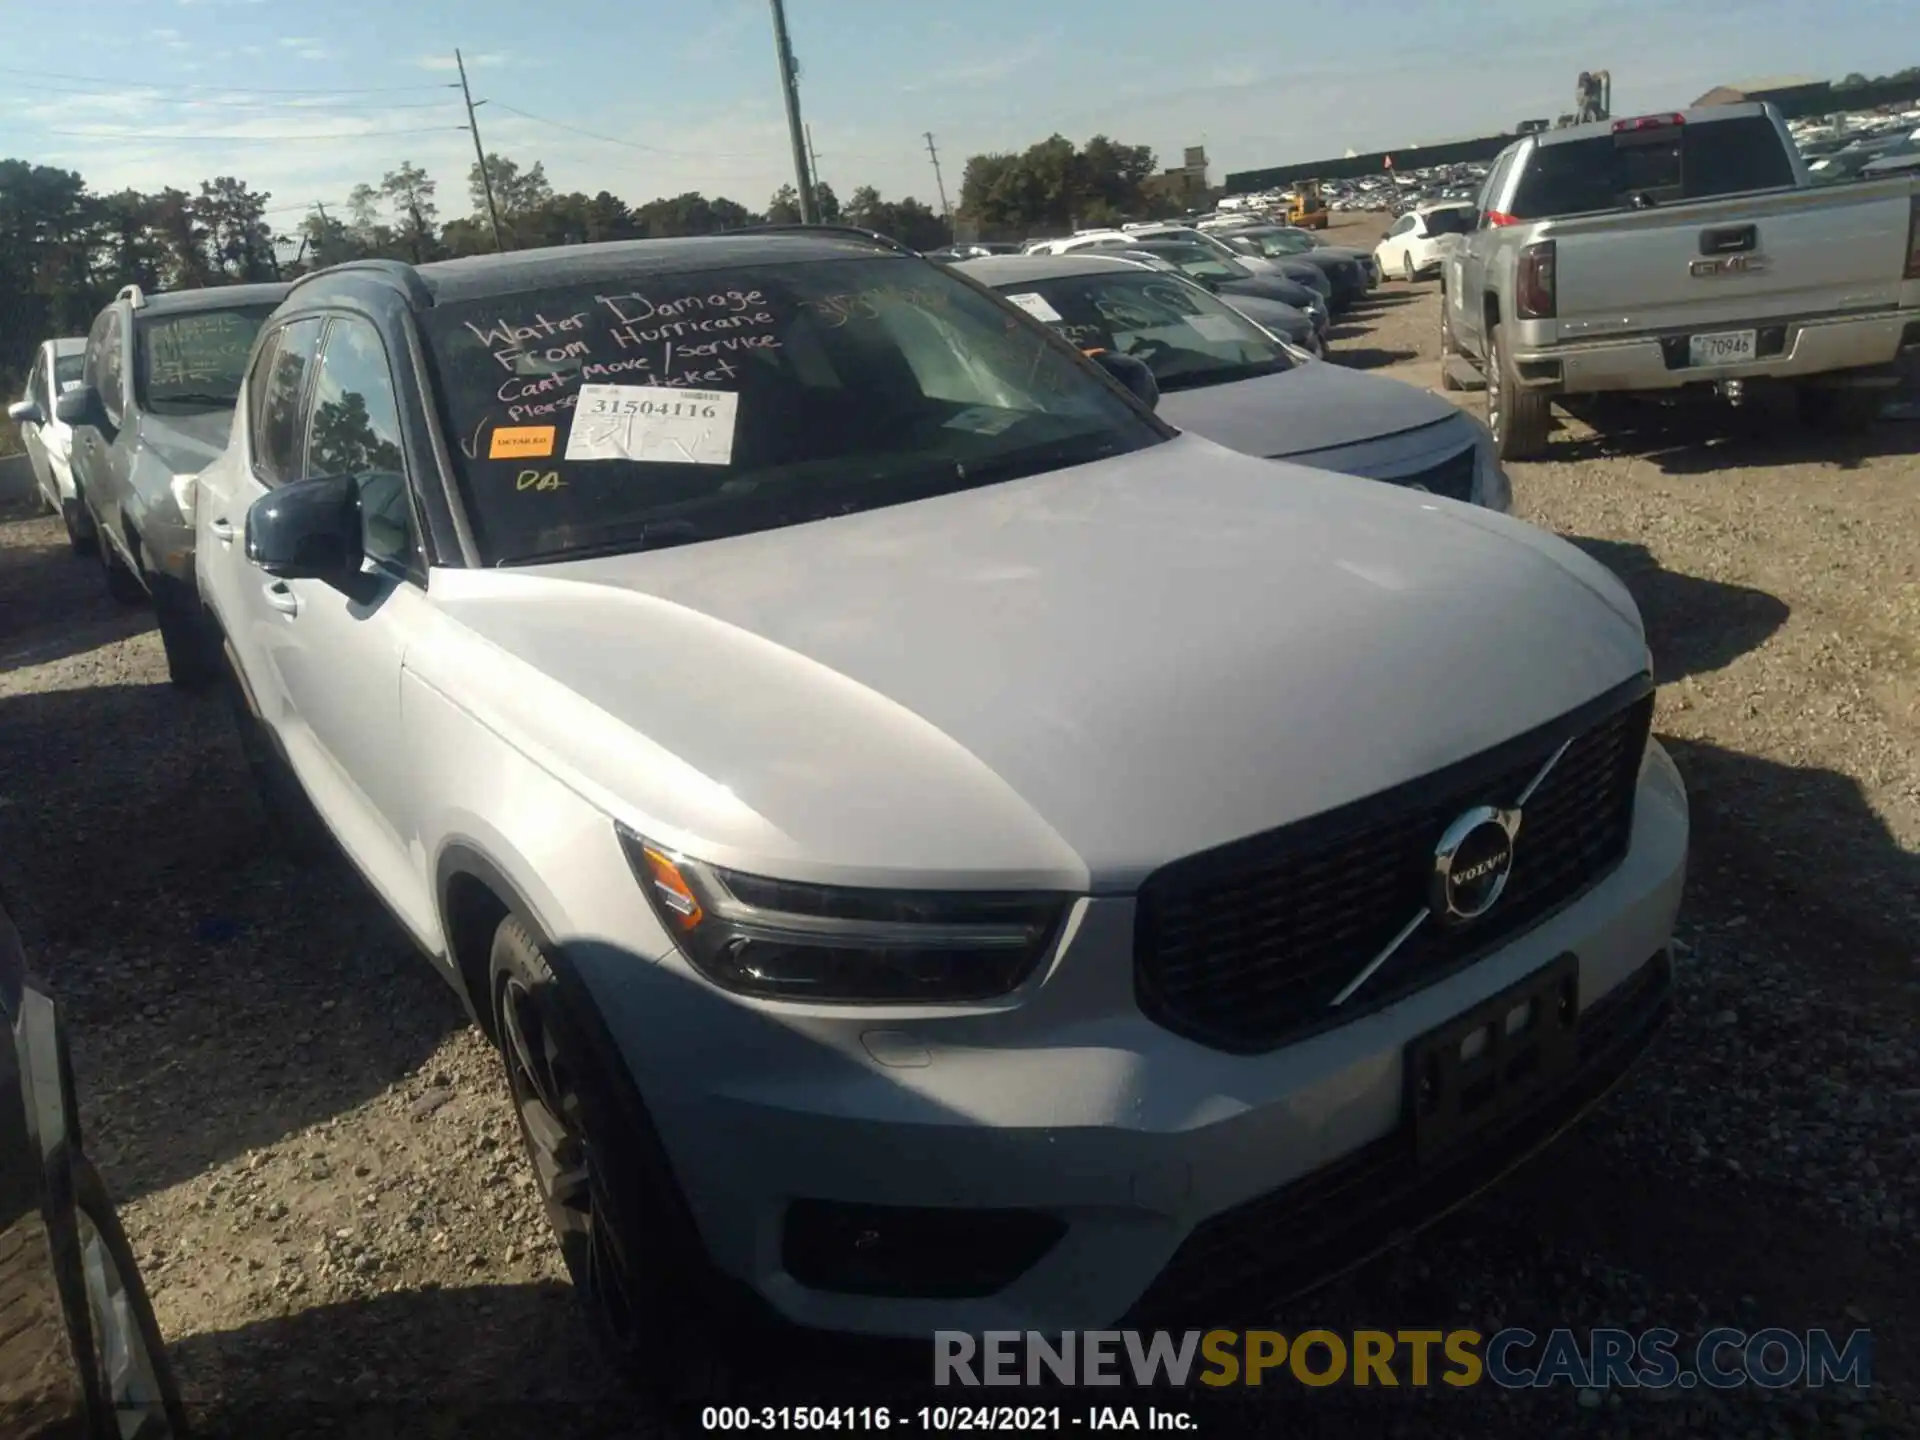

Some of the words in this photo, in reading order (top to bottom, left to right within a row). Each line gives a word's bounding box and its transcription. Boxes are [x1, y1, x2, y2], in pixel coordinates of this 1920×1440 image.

[464, 312, 590, 348] Water
[593, 290, 767, 325] Damage
[493, 341, 591, 372] From
[609, 311, 774, 349] Hurricane
[590, 399, 717, 419] 31504116
[1451, 851, 1508, 885] VOLVO
